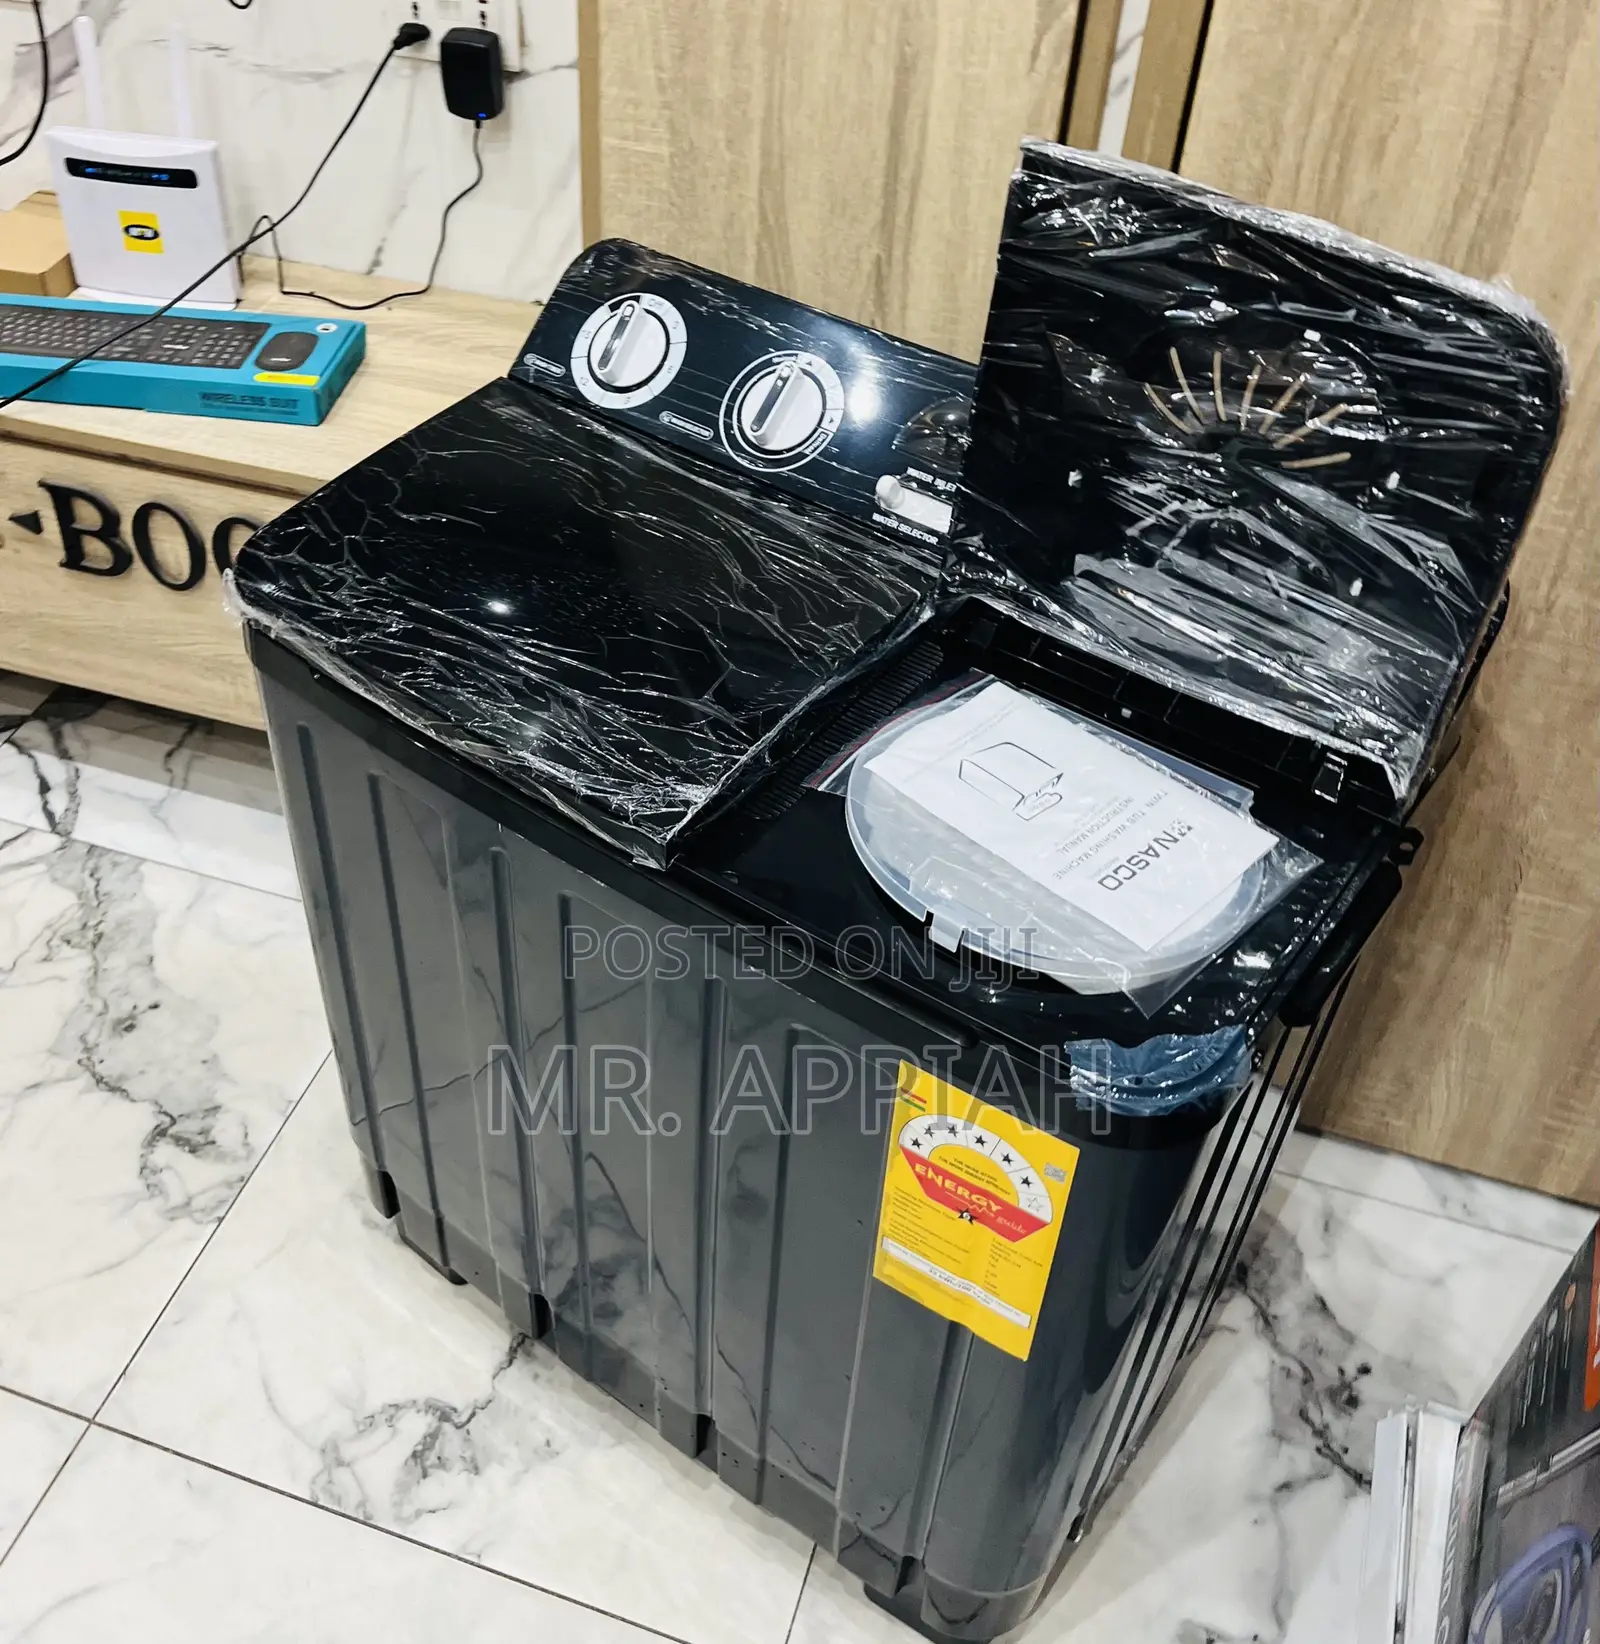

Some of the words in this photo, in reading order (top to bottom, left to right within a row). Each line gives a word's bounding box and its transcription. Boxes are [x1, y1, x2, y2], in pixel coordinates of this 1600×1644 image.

[199, 391, 266, 407] WIRELESS
[269, 397, 300, 410] SUIT
[907, 466, 934, 484] WATER
[872, 512, 899, 529] WATER
[898, 523, 939, 545] SELECTOR
[1145, 788, 1169, 809] TWIN
[1088, 796, 1135, 834] INSTRUCTION
[1127, 810, 1147, 825] TUB
[1055, 828, 1091, 856] MANUAL
[1089, 822, 1130, 855] WASHING
[1053, 850, 1093, 880] MACHINE
[1097, 830, 1180, 891] NASCO
[914, 1162, 1003, 1213] ENERGY
